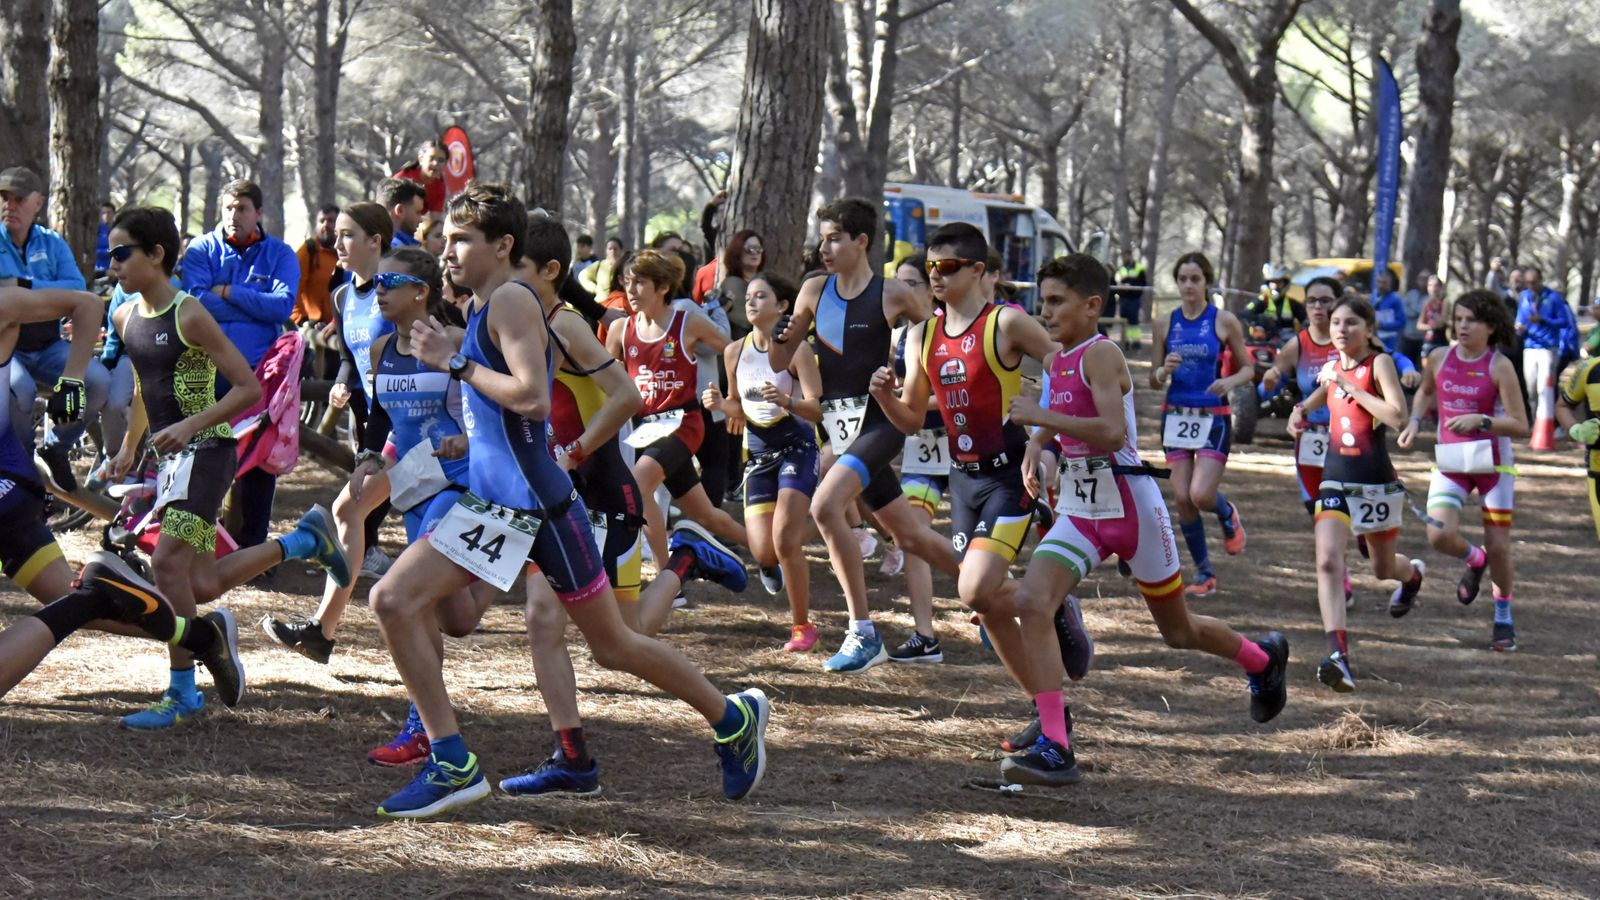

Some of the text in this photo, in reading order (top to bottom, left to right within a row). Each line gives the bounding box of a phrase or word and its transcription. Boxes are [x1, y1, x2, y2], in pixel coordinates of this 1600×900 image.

[350, 328, 371, 343] ELOISA
[386, 376, 417, 392] LUCÍA
[1442, 380, 1479, 395] Cesar
[945, 388, 969, 409] JULIO
[1050, 389, 1073, 405] Curro
[836, 416, 861, 441] 37
[1177, 421, 1201, 439] 28
[918, 443, 942, 464] 31
[1074, 477, 1098, 504] 47
[1359, 502, 1390, 524] 29
[458, 524, 506, 564] 44
